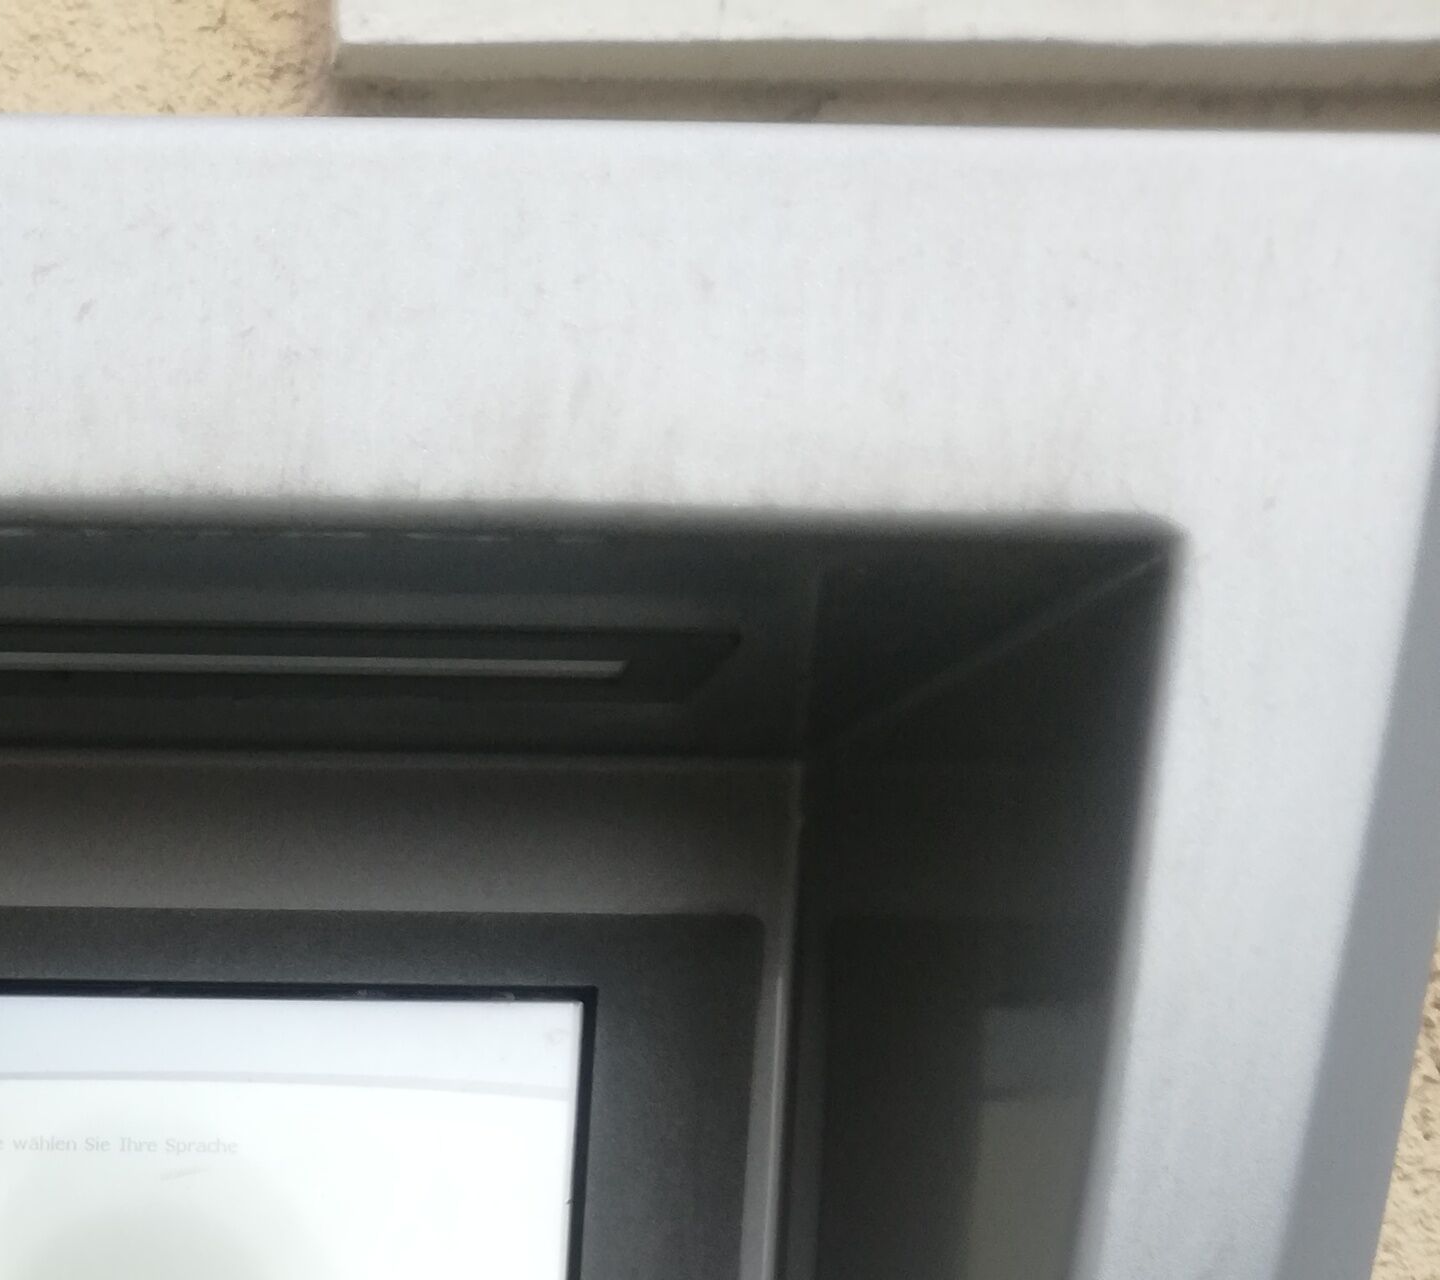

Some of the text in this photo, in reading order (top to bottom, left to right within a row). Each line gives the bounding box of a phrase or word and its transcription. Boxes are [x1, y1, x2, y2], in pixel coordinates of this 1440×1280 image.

[12, 1136, 77, 1152] wählen
[84, 1136, 111, 1153] Sie
[120, 1137, 158, 1154] Ihre
[165, 1138, 239, 1156] Sprache
